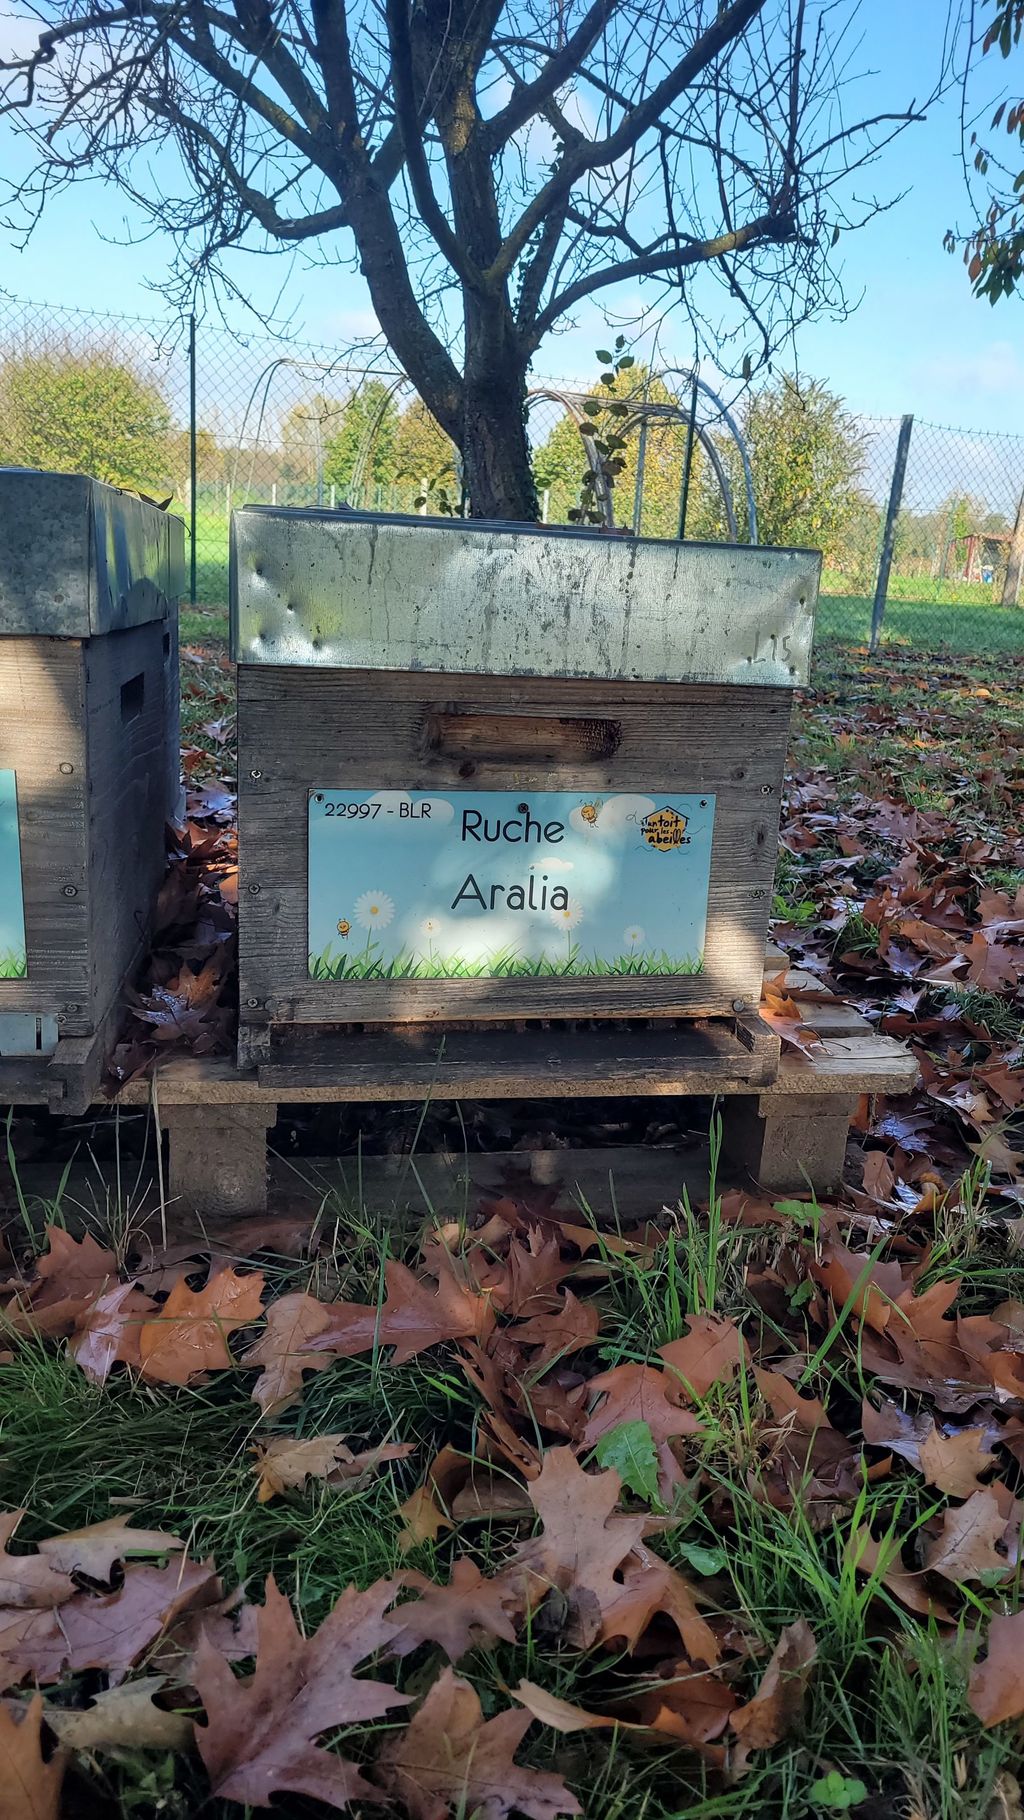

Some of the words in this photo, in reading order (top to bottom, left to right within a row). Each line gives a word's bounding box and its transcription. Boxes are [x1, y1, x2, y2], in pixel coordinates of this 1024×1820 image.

[324, 802, 382, 819] 22997
[399, 802, 432, 819] BLR
[461, 809, 565, 844] Ruche
[658, 815, 681, 827] toit
[640, 827, 659, 836] pour
[648, 829, 691, 844] abeilles
[450, 873, 569, 911] Aralia
